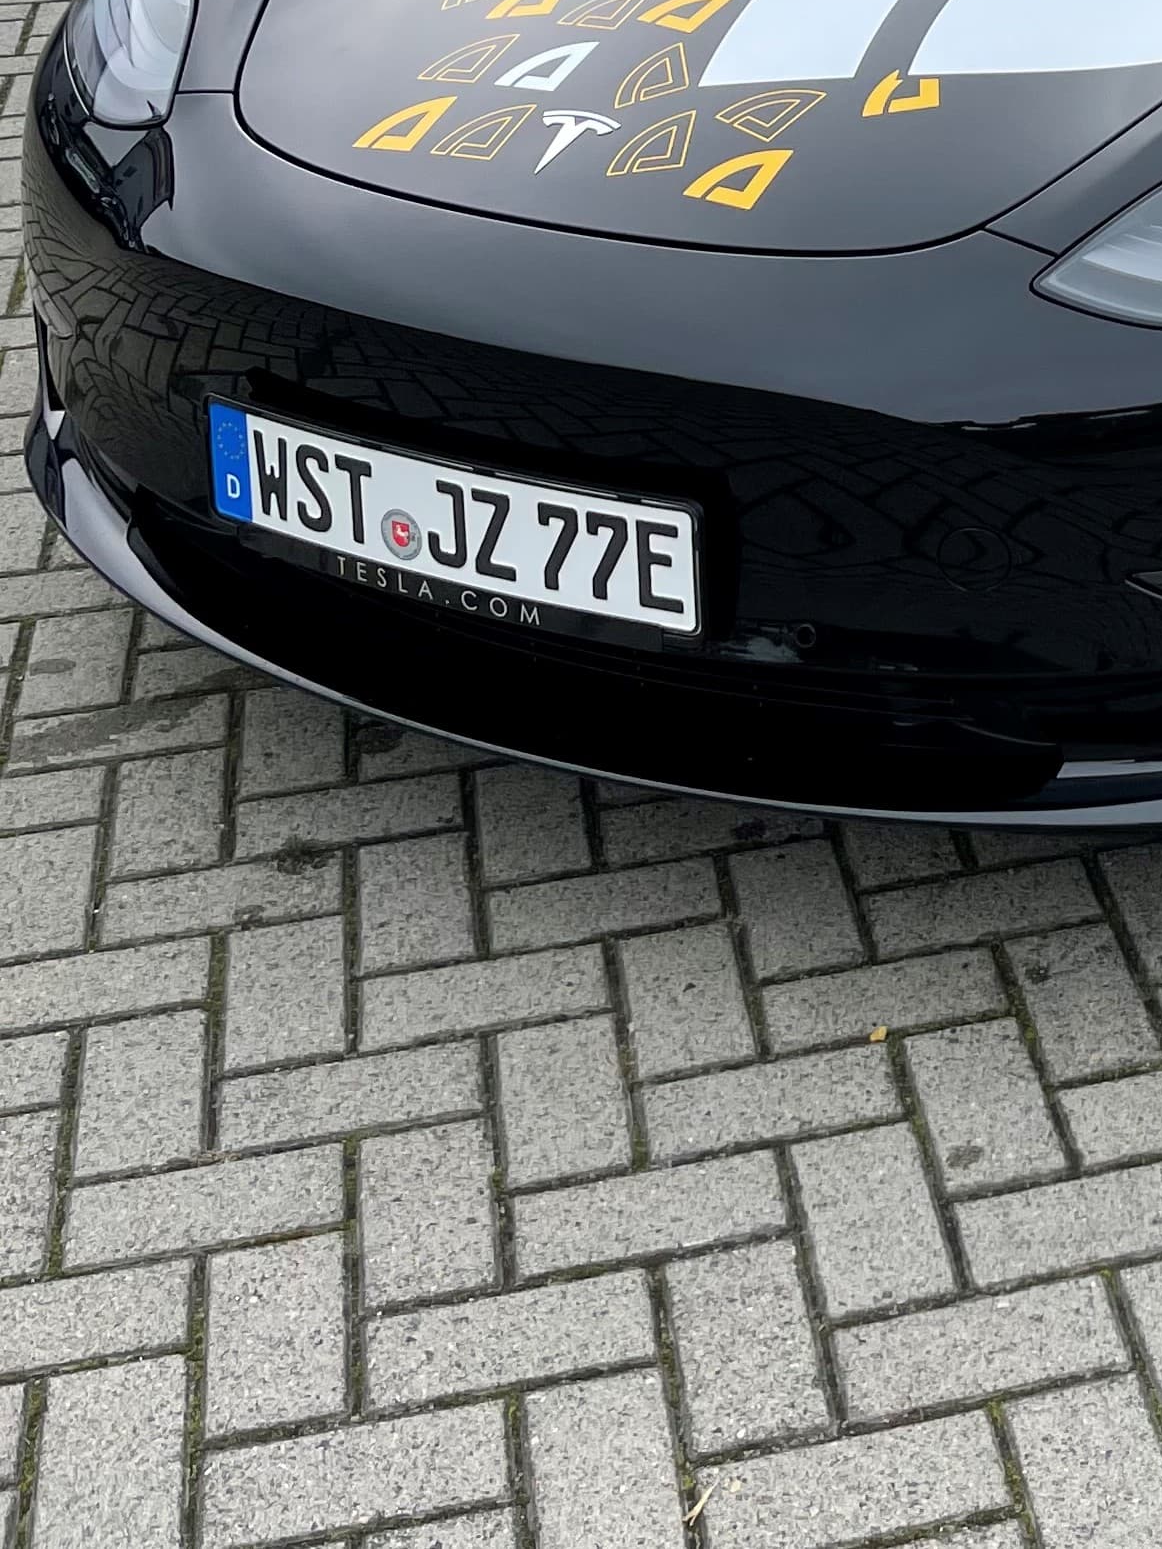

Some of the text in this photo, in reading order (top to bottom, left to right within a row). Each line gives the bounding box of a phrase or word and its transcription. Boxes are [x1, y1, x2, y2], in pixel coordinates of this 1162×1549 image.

[226, 429, 685, 614] D WST JZ 77E
[336, 555, 542, 627] TESLA.COM
